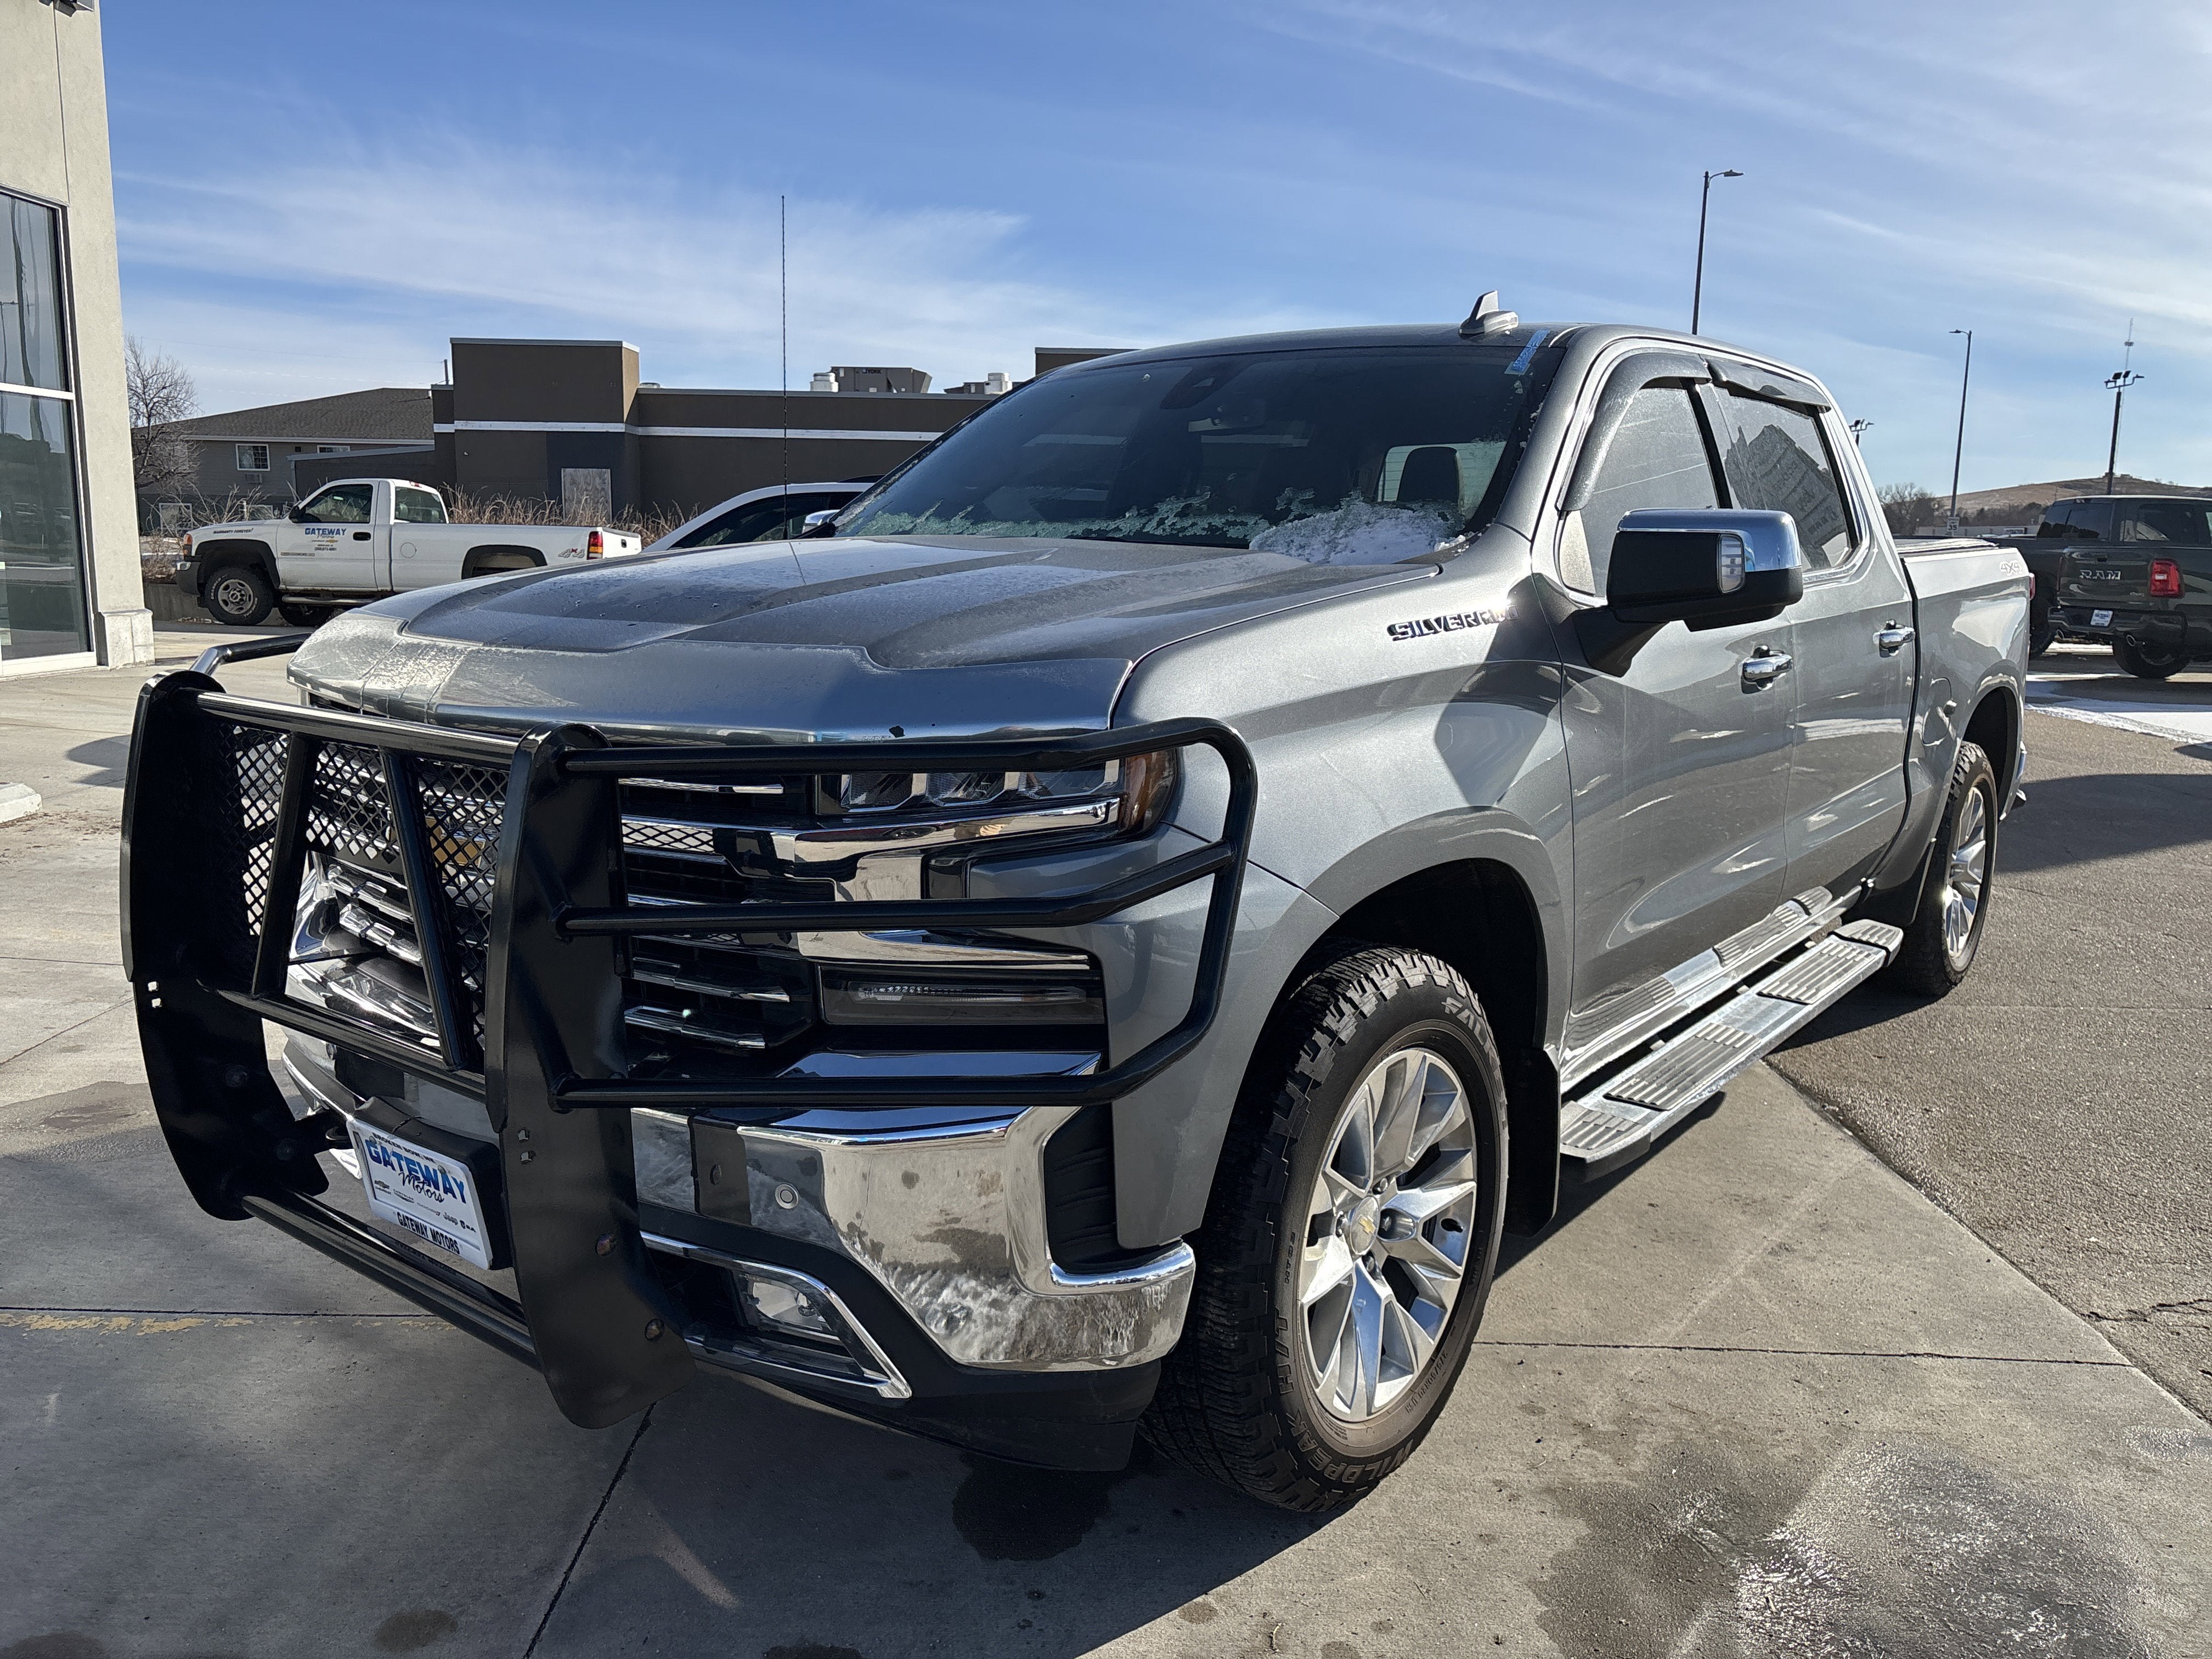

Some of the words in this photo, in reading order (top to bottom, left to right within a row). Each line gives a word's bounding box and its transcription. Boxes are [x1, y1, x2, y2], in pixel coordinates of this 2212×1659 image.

[2079, 569, 2121, 580] RAM
[365, 1138, 466, 1204] GATEWAY
[398, 1171, 444, 1203] Motors
[397, 1212, 428, 1238] GATEWAY
[430, 1227, 460, 1255] MOTORS
[1288, 1408, 1414, 1483] WILDPEAK
